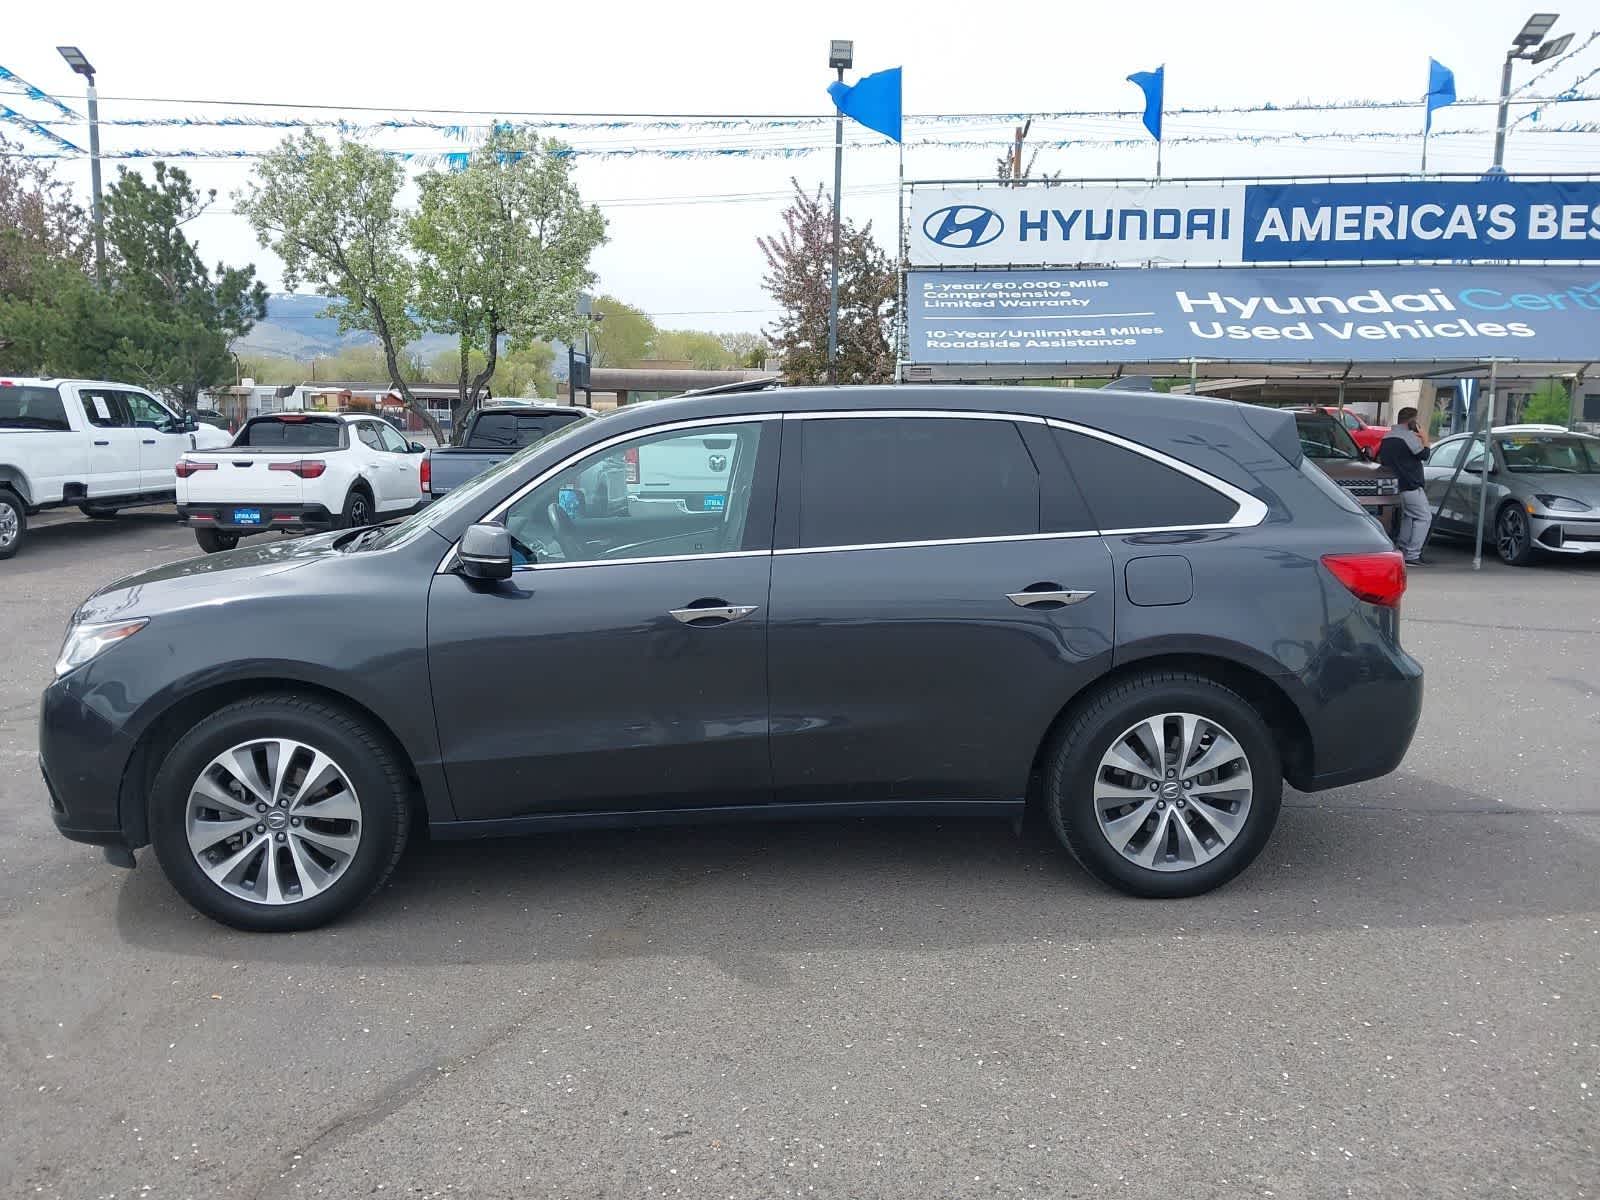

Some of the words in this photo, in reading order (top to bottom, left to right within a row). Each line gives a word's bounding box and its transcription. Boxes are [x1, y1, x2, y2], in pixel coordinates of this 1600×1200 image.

[1019, 208, 1230, 242] HYUNDAI
[1255, 203, 1516, 242] AMERICA'S
[923, 290, 1072, 300] Comprehensive
[924, 300, 996, 308] Limited
[999, 299, 1090, 308] Warranty
[1175, 287, 1456, 320] Hyundai
[925, 328, 1106, 339] 10-Year/Unlimited
[1110, 326, 1165, 337] Miles
[1188, 320, 1314, 341] Used
[1318, 318, 1537, 340] Vehicles
[926, 339, 1020, 349] Roadside
[1025, 337, 1137, 348] Assistance
